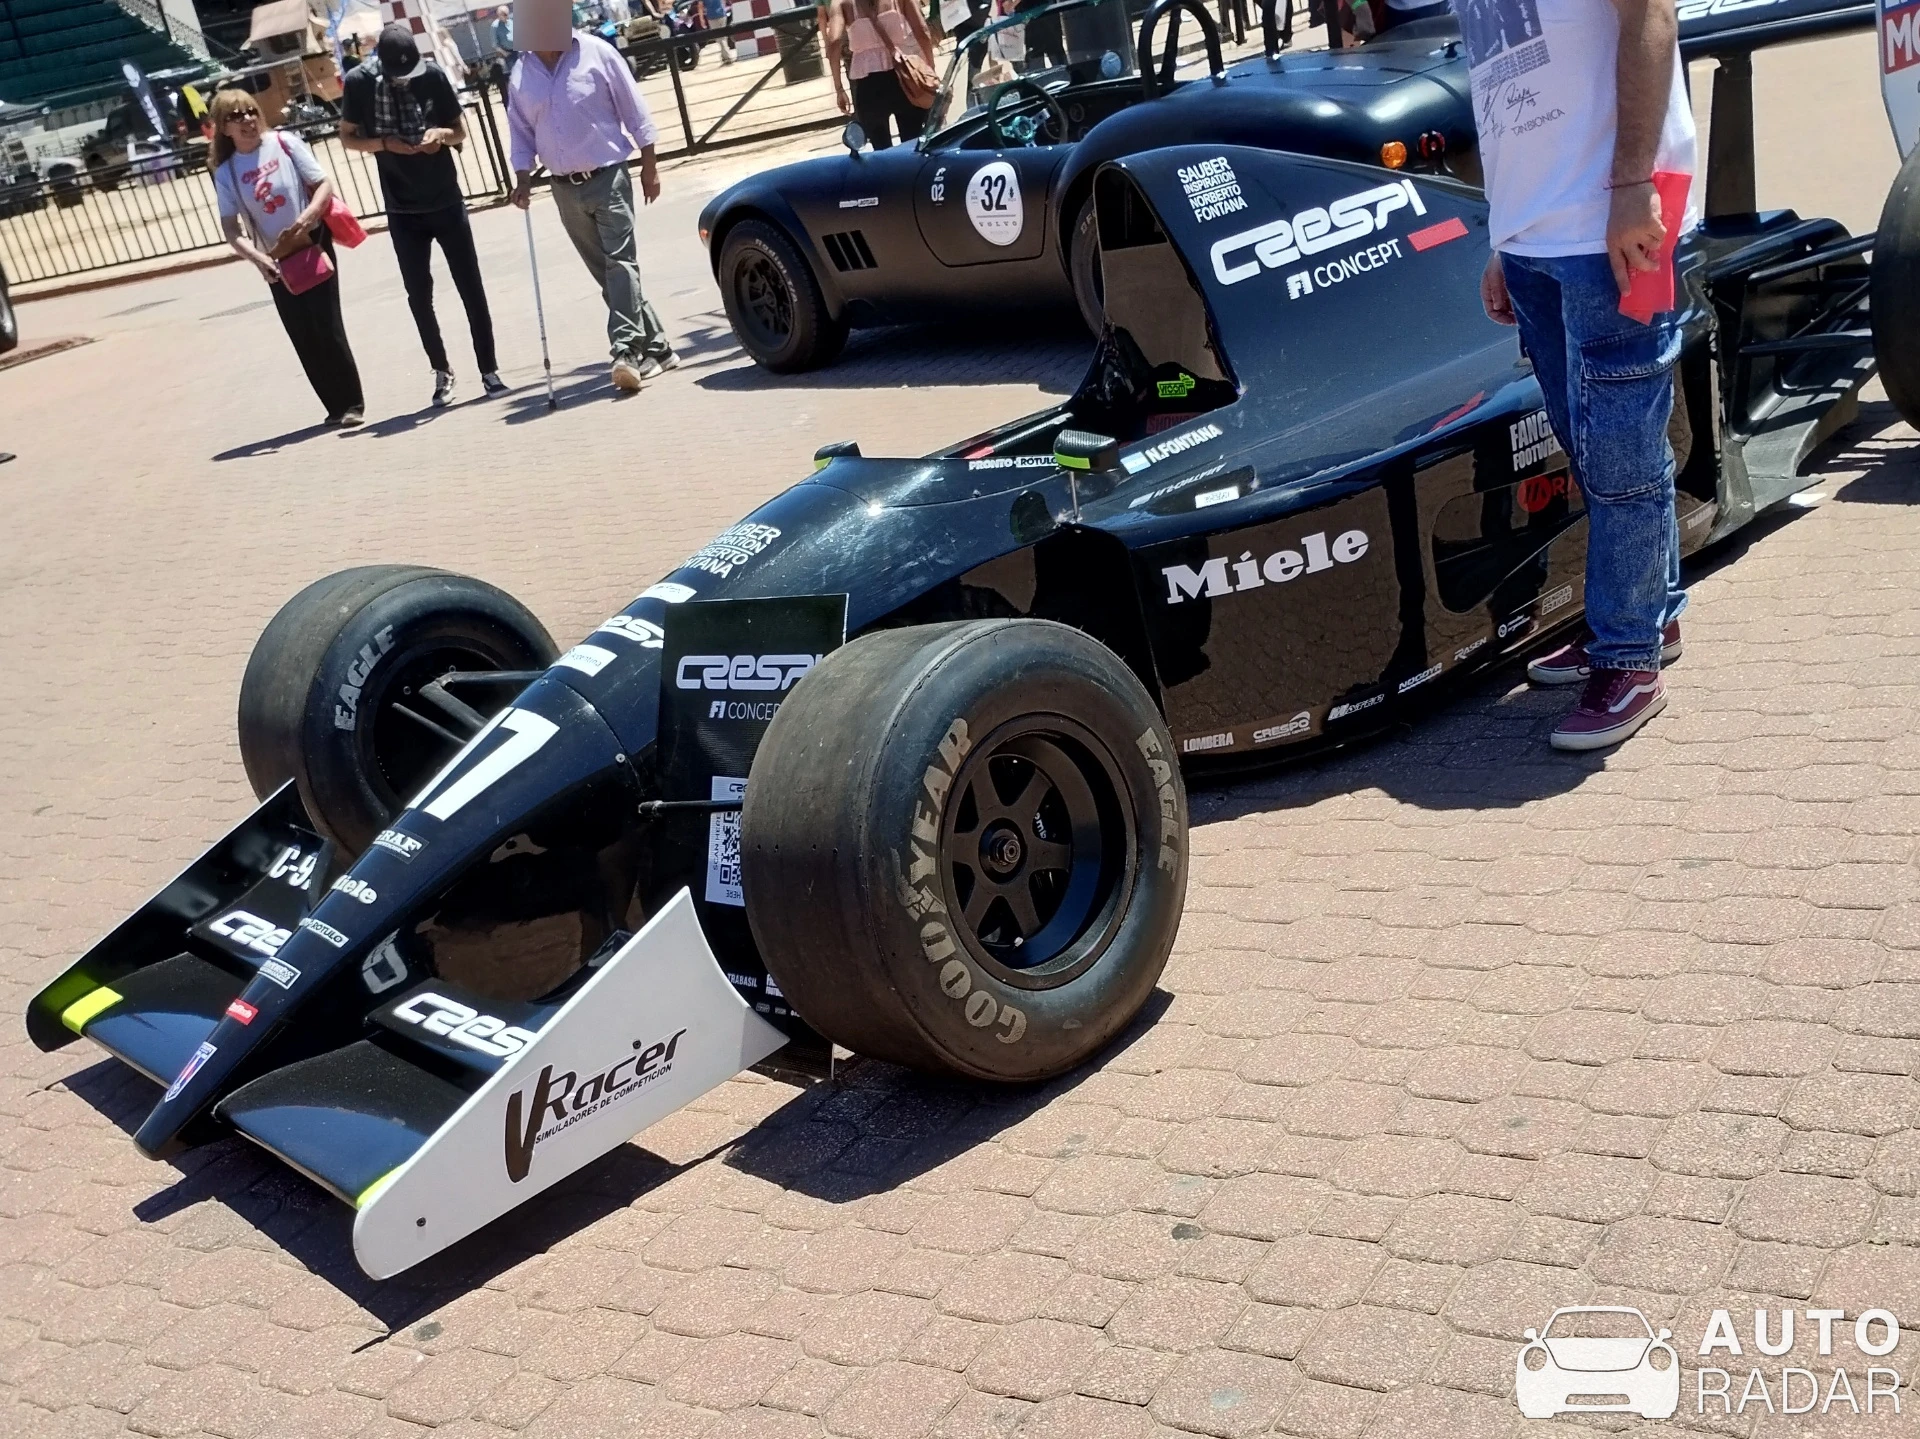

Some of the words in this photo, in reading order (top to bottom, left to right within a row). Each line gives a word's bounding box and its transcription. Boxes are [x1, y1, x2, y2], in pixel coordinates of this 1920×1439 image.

[1177, 156, 1232, 184] SAUBER
[1183, 170, 1236, 195] INSPIRATION
[931, 183, 945, 202] 02
[980, 174, 1008, 212] 32
[1188, 184, 1242, 210] NORBERTO
[1194, 195, 1249, 223] FONTANA
[1313, 238, 1403, 288] CONCEPT
[1145, 423, 1224, 464] N.FONTANA
[1509, 410, 1554, 452] FANG
[968, 459, 1013, 471] PRONTO
[1512, 435, 1563, 472] FOOTWE
[1161, 529, 1369, 605] Miele
[334, 624, 396, 732] EAGLE
[1252, 718, 1311, 741] CRESPO
[1136, 726, 1180, 882] EAGLE
[910, 717, 1028, 1045] GOODYEAR
[209, 910, 293, 957] CRE
[392, 992, 538, 1062] CRES
[535, 1105, 599, 1145] SIMULADORES
[599, 1094, 613, 1110] DE
[613, 1062, 673, 1102] COMPETICION
